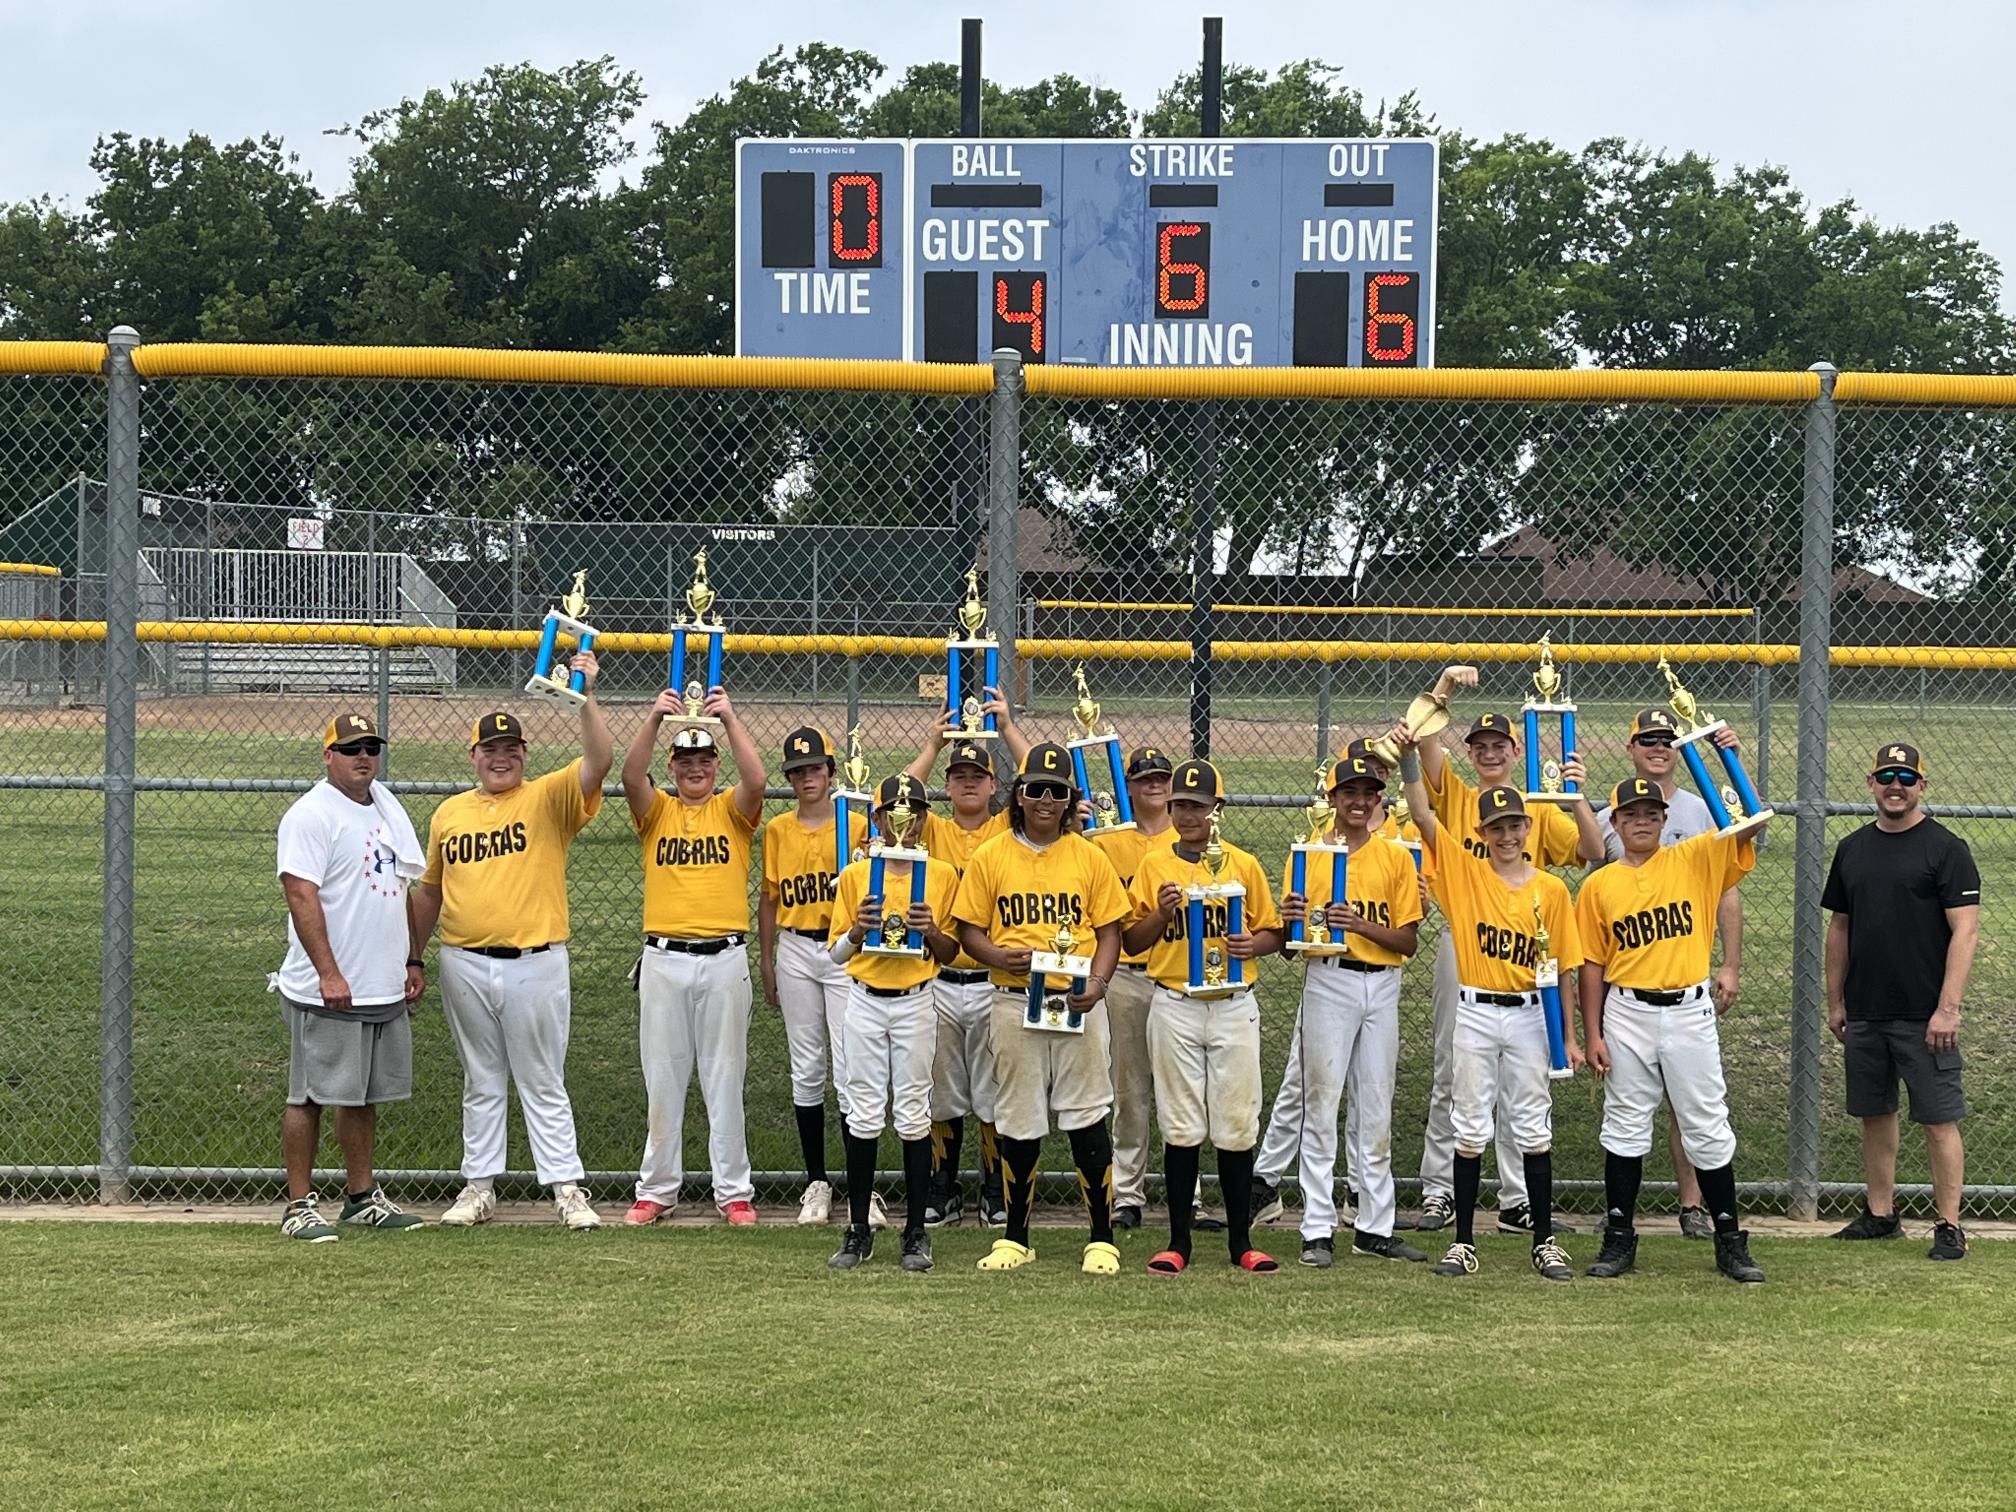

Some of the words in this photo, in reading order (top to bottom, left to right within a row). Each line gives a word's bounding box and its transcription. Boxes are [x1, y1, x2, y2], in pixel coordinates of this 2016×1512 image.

[788, 147, 856, 155] DAKTRONICS
[951, 144, 1022, 178] BALL
[1129, 144, 1235, 178] STRIKE
[1328, 144, 1391, 177] OUT
[832, 175, 880, 261] 0
[921, 219, 1051, 263] GUEST
[1301, 219, 1415, 263] HOME
[1159, 224, 1206, 311] 6
[773, 272, 871, 315] TIME
[996, 279, 1043, 355] 4
[1366, 274, 1415, 361] 6
[1109, 323, 1254, 366] INNING
[711, 528, 776, 541] VISITORS
[496, 715, 508, 730] C
[1044, 750, 1057, 769] C
[1353, 758, 1367, 773] C
[1185, 768, 1199, 787] C
[1635, 779, 1649, 794] C
[1493, 790, 1507, 807] C
[442, 821, 527, 865] COBRAS
[656, 835, 730, 866] COBRAS
[997, 892, 1082, 928] COBRAS
